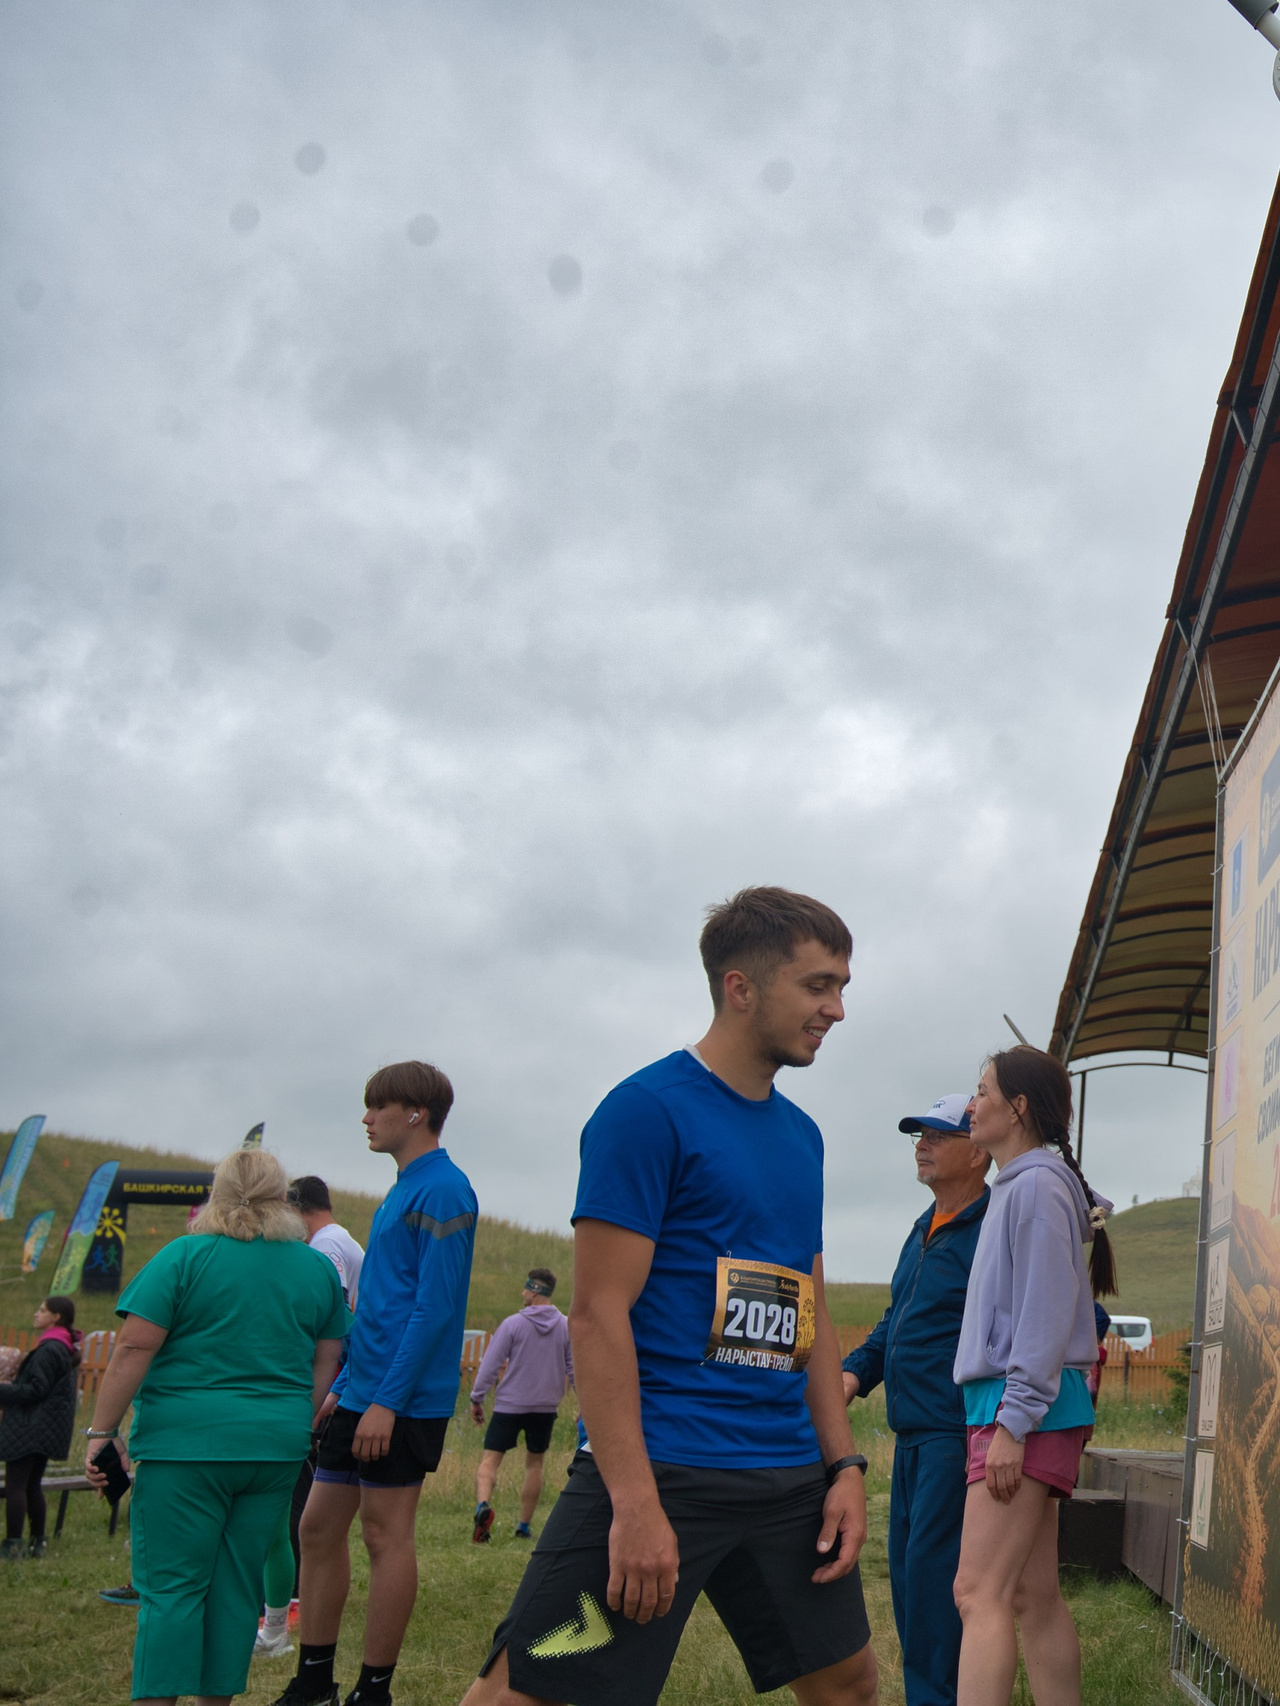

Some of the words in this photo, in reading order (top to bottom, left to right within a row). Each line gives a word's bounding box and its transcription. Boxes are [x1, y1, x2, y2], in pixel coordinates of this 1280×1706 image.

[1262, 1032, 1280, 1088] БЕГИ
[1257, 1086, 1280, 1145] СВОИМ
[123, 1182, 204, 1194] БАШКИРСКАЯ
[724, 1298, 796, 1345] 2028
[715, 1347, 794, 1372] НАРЫСТАУ-ТРЕЙЛ
